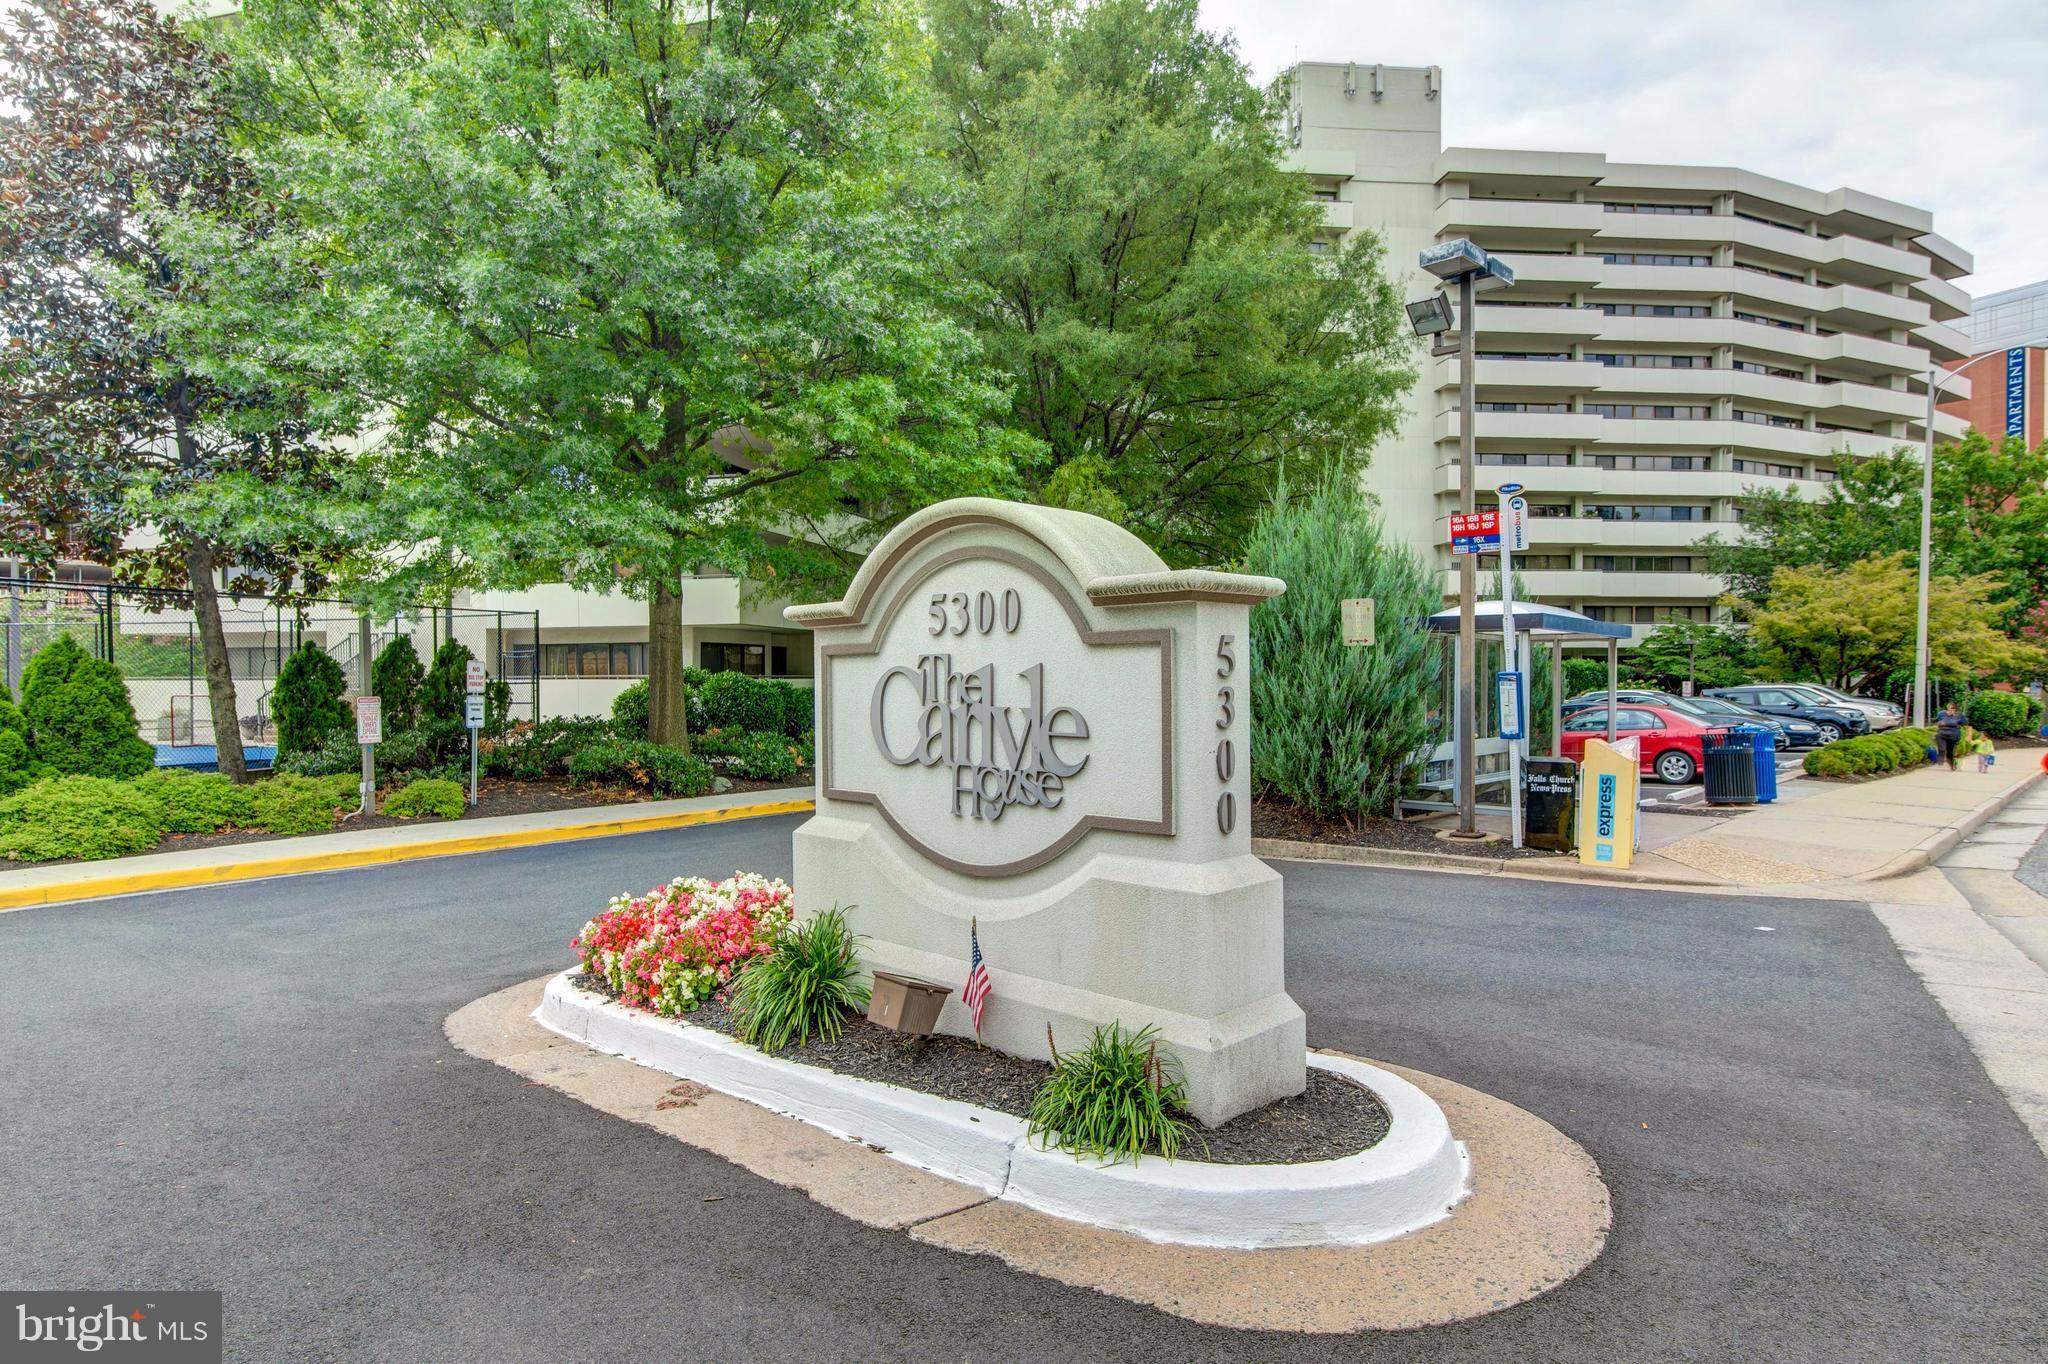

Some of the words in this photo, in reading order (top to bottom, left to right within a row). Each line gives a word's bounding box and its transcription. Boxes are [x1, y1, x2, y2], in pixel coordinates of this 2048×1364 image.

[1452, 516, 1465, 524] 16A
[1467, 514, 1479, 523] 16B
[1482, 513, 1495, 521] 16E
[1452, 524, 1465, 532] 16H
[1467, 522, 1480, 530] 16J
[1481, 521, 1494, 529] 16P
[1473, 535, 1485, 543] 16X
[928, 588, 1021, 636] 5300
[917, 653, 984, 706] The
[870, 662, 1090, 820] Carlyle
[1216, 634, 1237, 835] 5300
[951, 764, 1064, 818] House
[1527, 774, 1546, 783] Falls
[1549, 774, 1575, 784] Church
[1599, 777, 1613, 836] express
